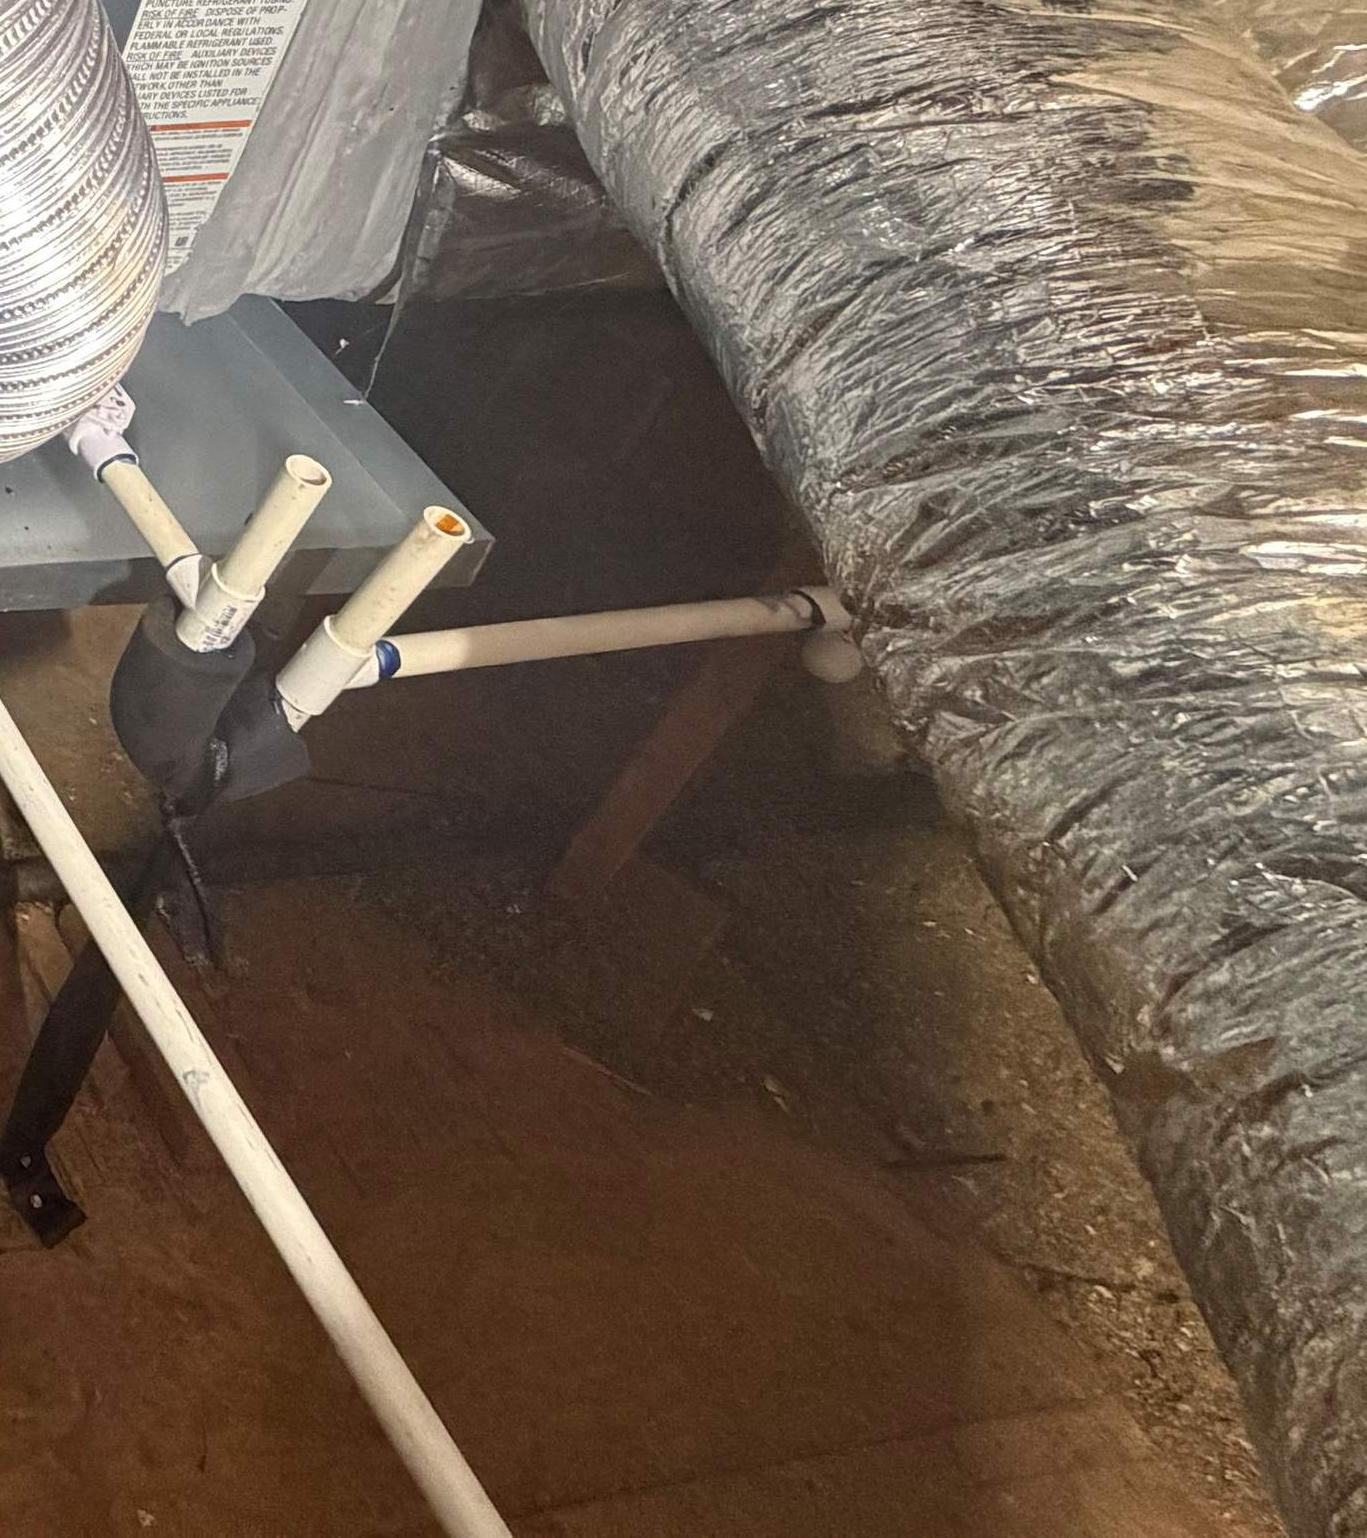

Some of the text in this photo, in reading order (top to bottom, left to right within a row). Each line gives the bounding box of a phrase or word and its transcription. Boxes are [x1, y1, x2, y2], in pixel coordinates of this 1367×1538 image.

[141, 9, 162, 19] RISK
[164, 9, 177, 18] OF
[178, 8, 199, 18] FIRE
[205, 7, 244, 16] DISPOSE
[246, 7, 258, 15] OF
[163, 20, 174, 29] IN
[175, 18, 234, 28] ACCORDANCE
[237, 17, 261, 25] WITH
[133, 30, 173, 40] FEDERAL
[175, 30, 188, 38] OR
[190, 29, 218, 38] LOCAL
[130, 41, 184, 50] FLAMMABLE
[186, 39, 247, 48] REFRIGERANT
[127, 47, 277, 62] RISK OF FIRE AUXILIARY DEVICES
[156, 62, 174, 70] MAY
[177, 61, 187, 69] BE
[190, 60, 230, 69] IGNITION
[231, 58, 273, 66] SOURCES
[149, 71, 167, 80] NOT
[169, 70, 182, 79] BE
[183, 68, 230, 78] INSTALLED
[232, 68, 243, 76] IN
[244, 67, 261, 76] THE
[200, 79, 223, 87] THAN
[160, 91, 196, 99] DEVICES
[198, 89, 229, 97] LISTED
[230, 88, 248, 96] FOR
[153, 100, 170, 109] THE
[171, 98, 209, 108] SPECIFIC
